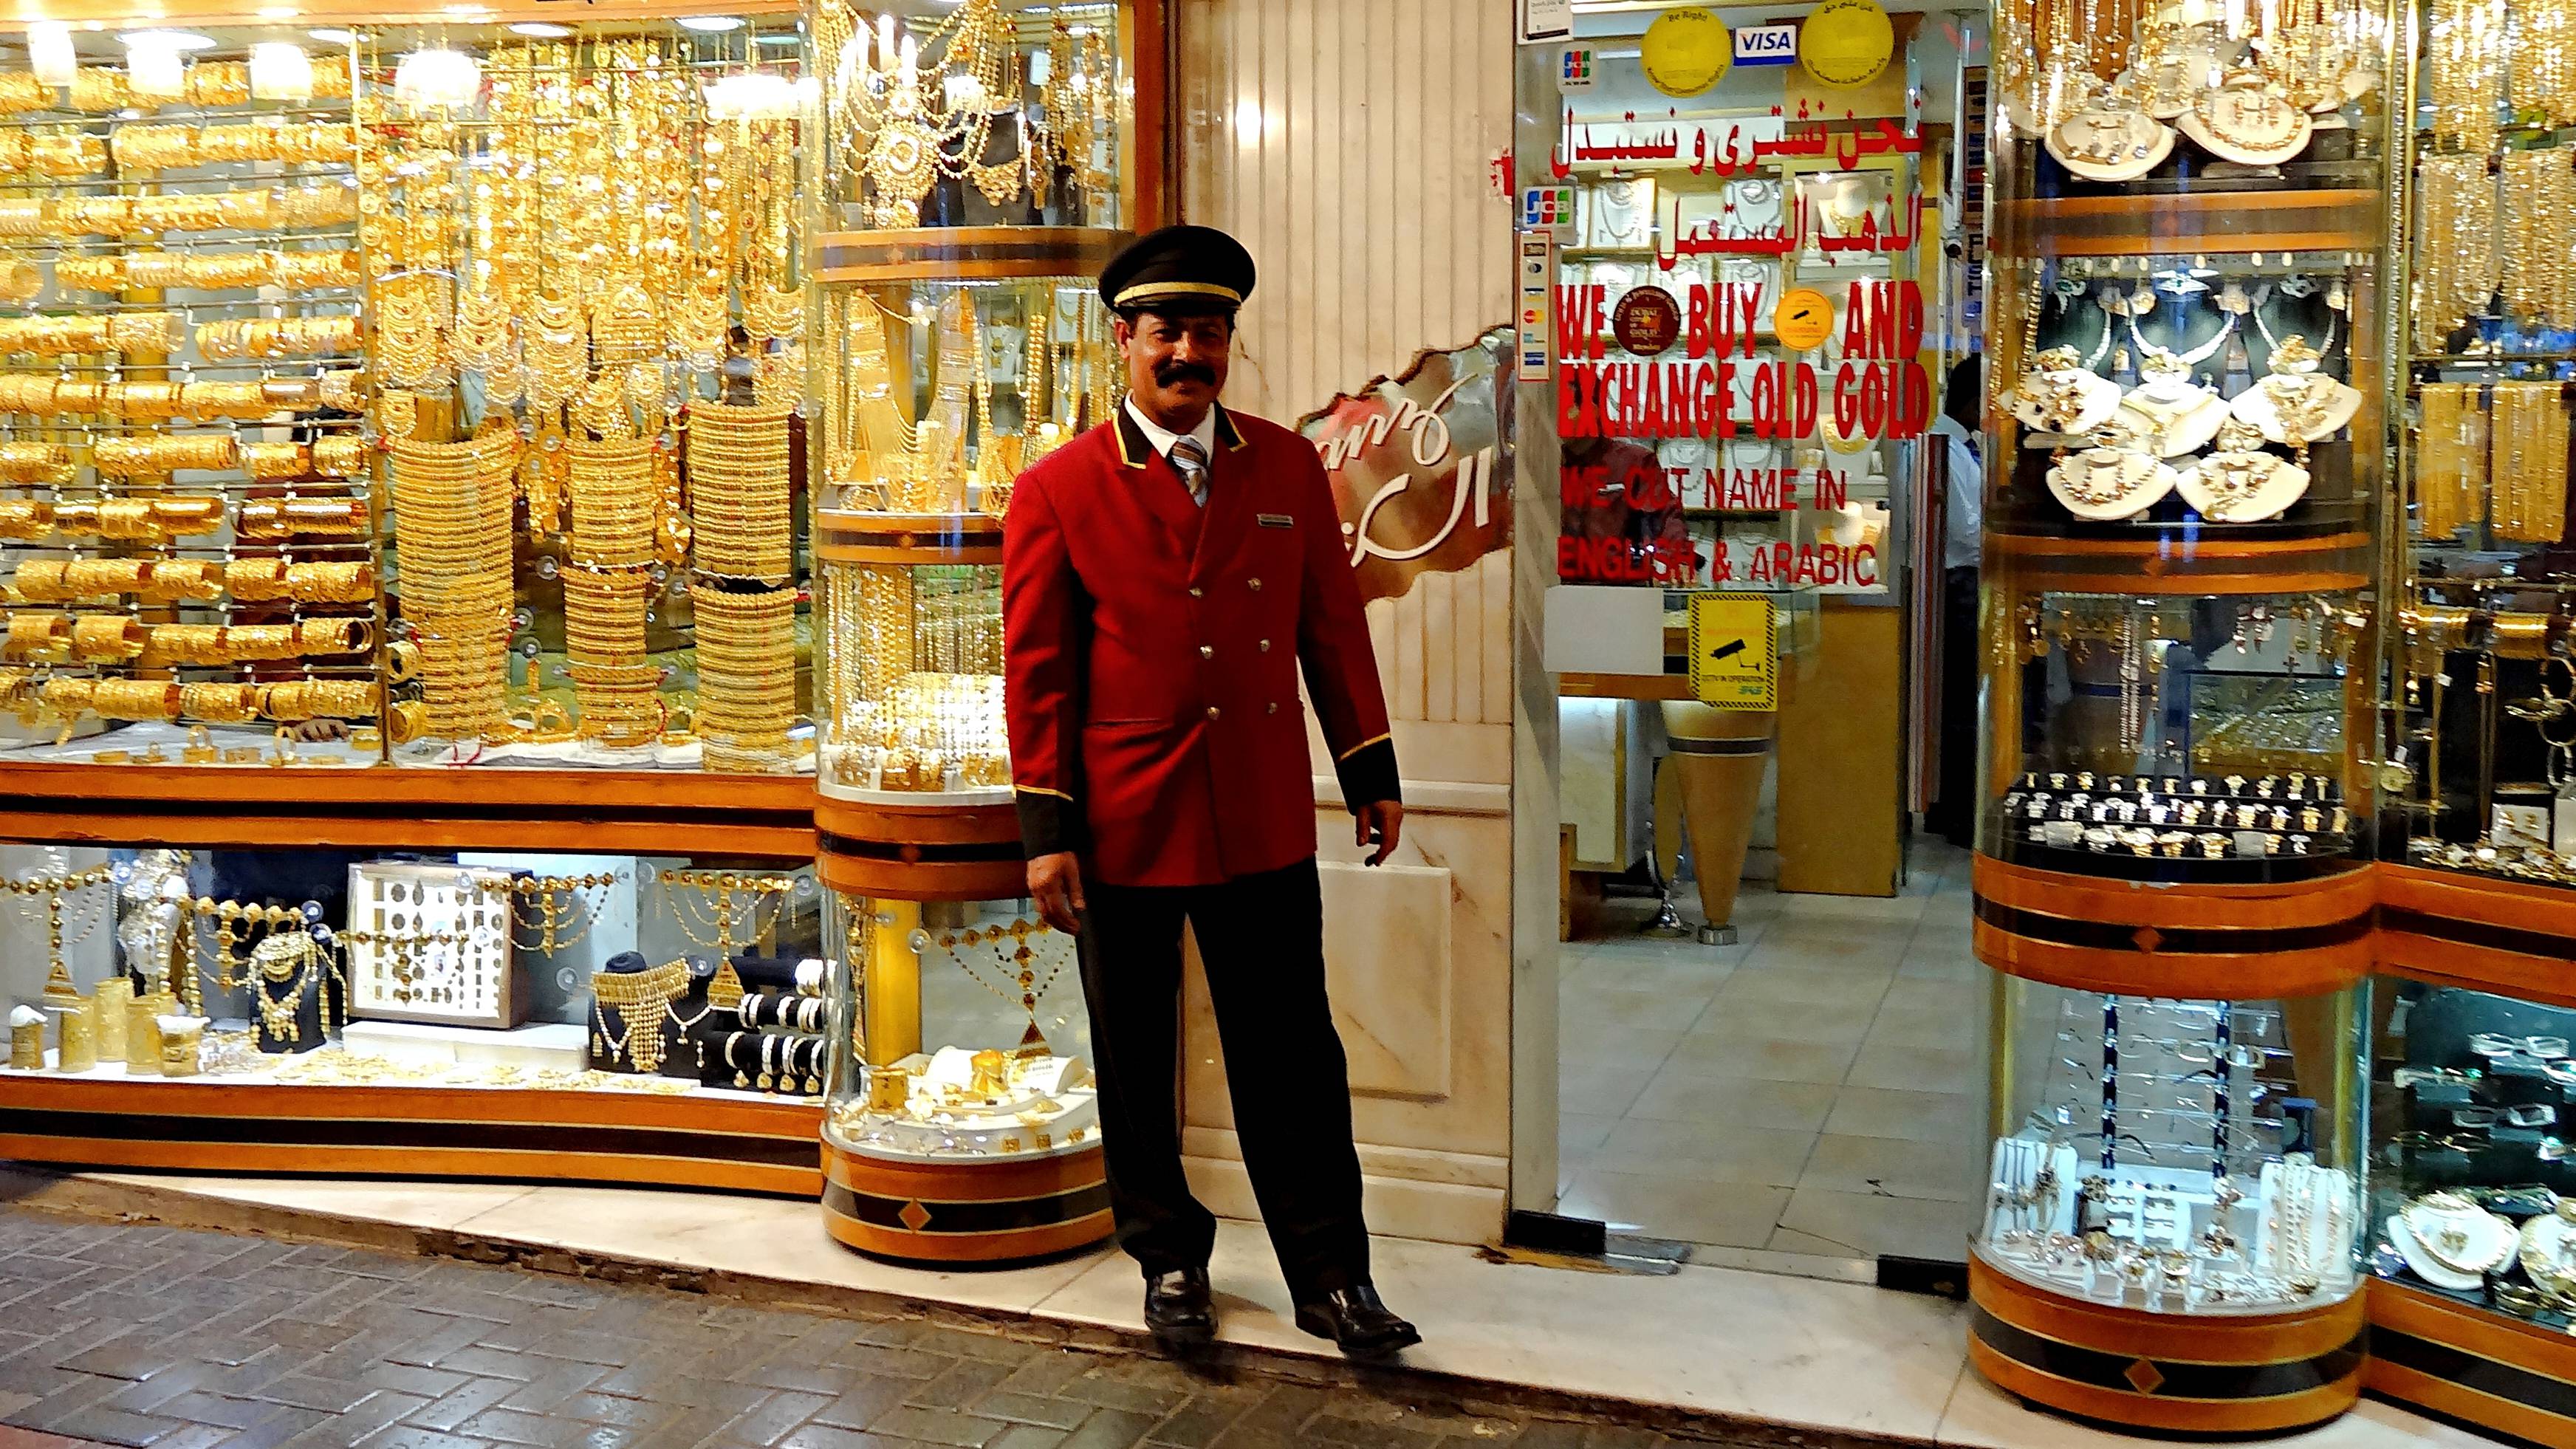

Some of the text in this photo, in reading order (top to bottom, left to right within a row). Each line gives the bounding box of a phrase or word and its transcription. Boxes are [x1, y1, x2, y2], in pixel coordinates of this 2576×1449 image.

[1742, 32, 1792, 51] VISA
[1837, 98, 1923, 171] نحن
[1527, 190, 1570, 225] JCB
[1555, 284, 1606, 360] WE
[1687, 282, 1763, 360] BUY
[1843, 281, 1924, 360] AND
[1558, 362, 1930, 440] EXCHANGE OLD GOLD
[1561, 466, 1846, 510] WE CUT NAME IN
[1558, 535, 1877, 586] ENGLISH & ARABIC
